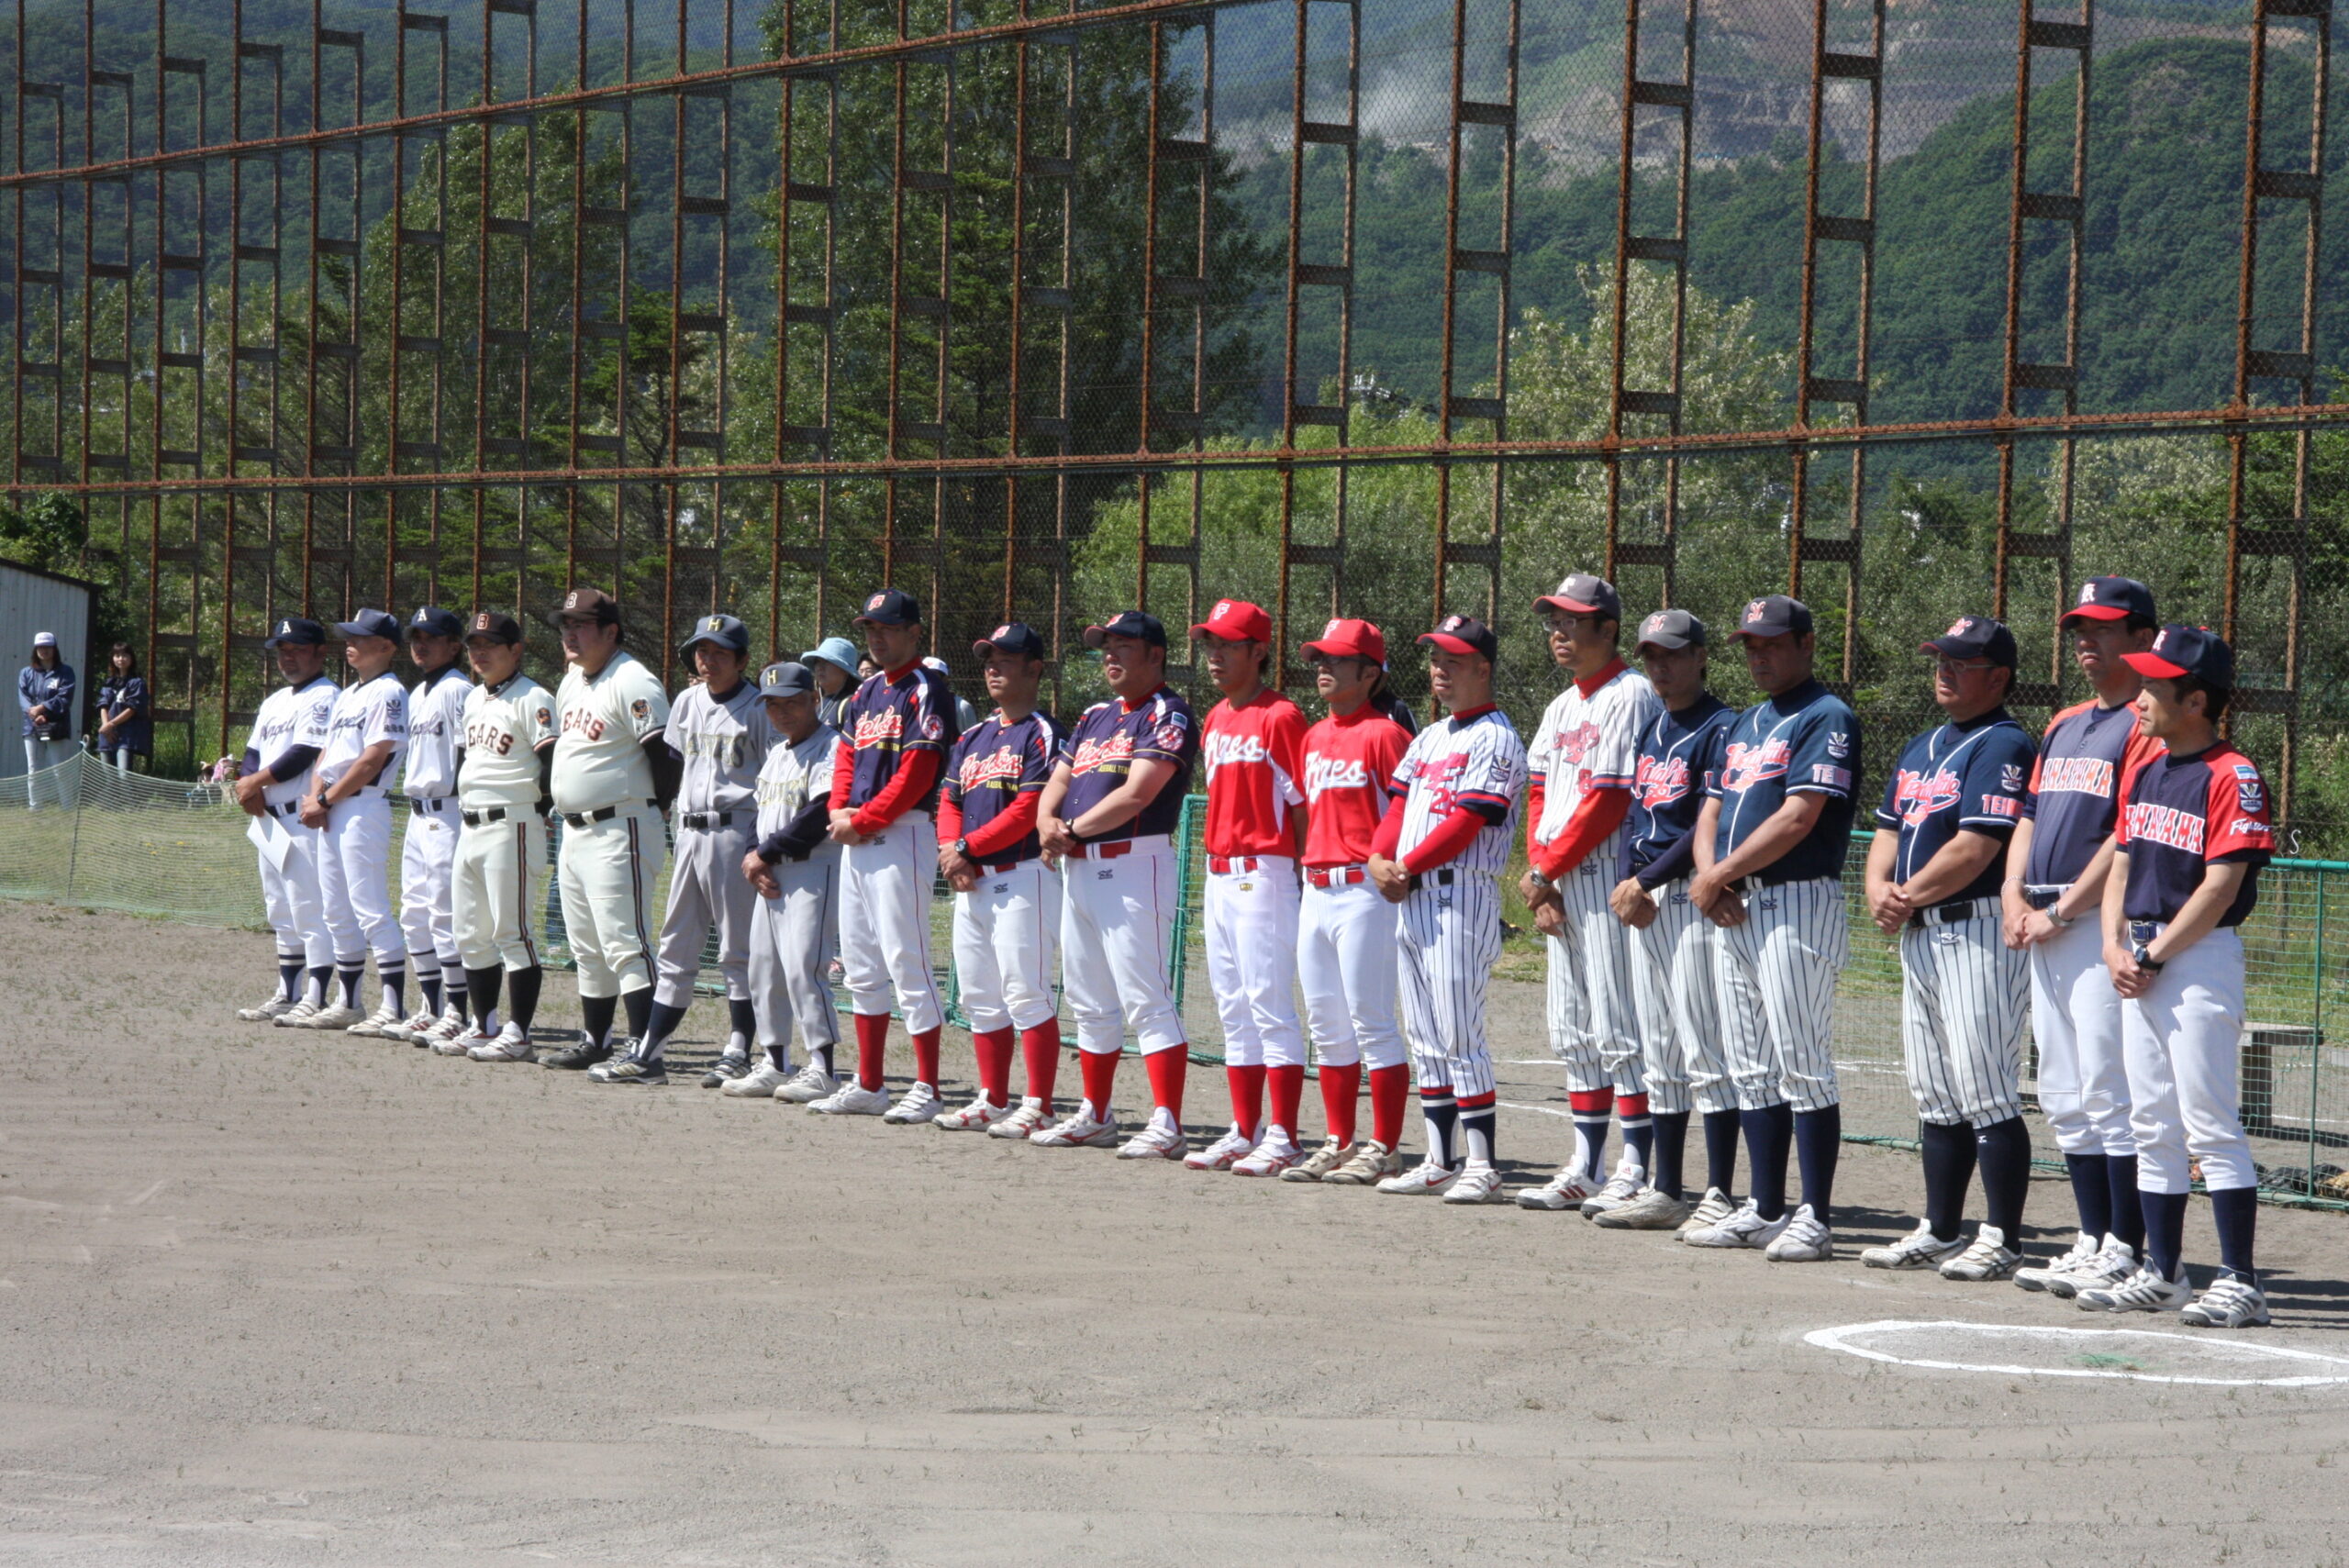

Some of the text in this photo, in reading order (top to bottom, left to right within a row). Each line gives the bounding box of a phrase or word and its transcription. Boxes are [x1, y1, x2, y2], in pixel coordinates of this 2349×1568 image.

[565, 592, 578, 609] B
[417, 608, 428, 623] A
[1213, 602, 1230, 620] F
[282, 620, 292, 634] A
[476, 613, 489, 629] B
[707, 617, 722, 632] H
[1323, 619, 1341, 639] F
[766, 669, 779, 686] H
[562, 708, 606, 741] EARS
[468, 724, 514, 755] EARS
